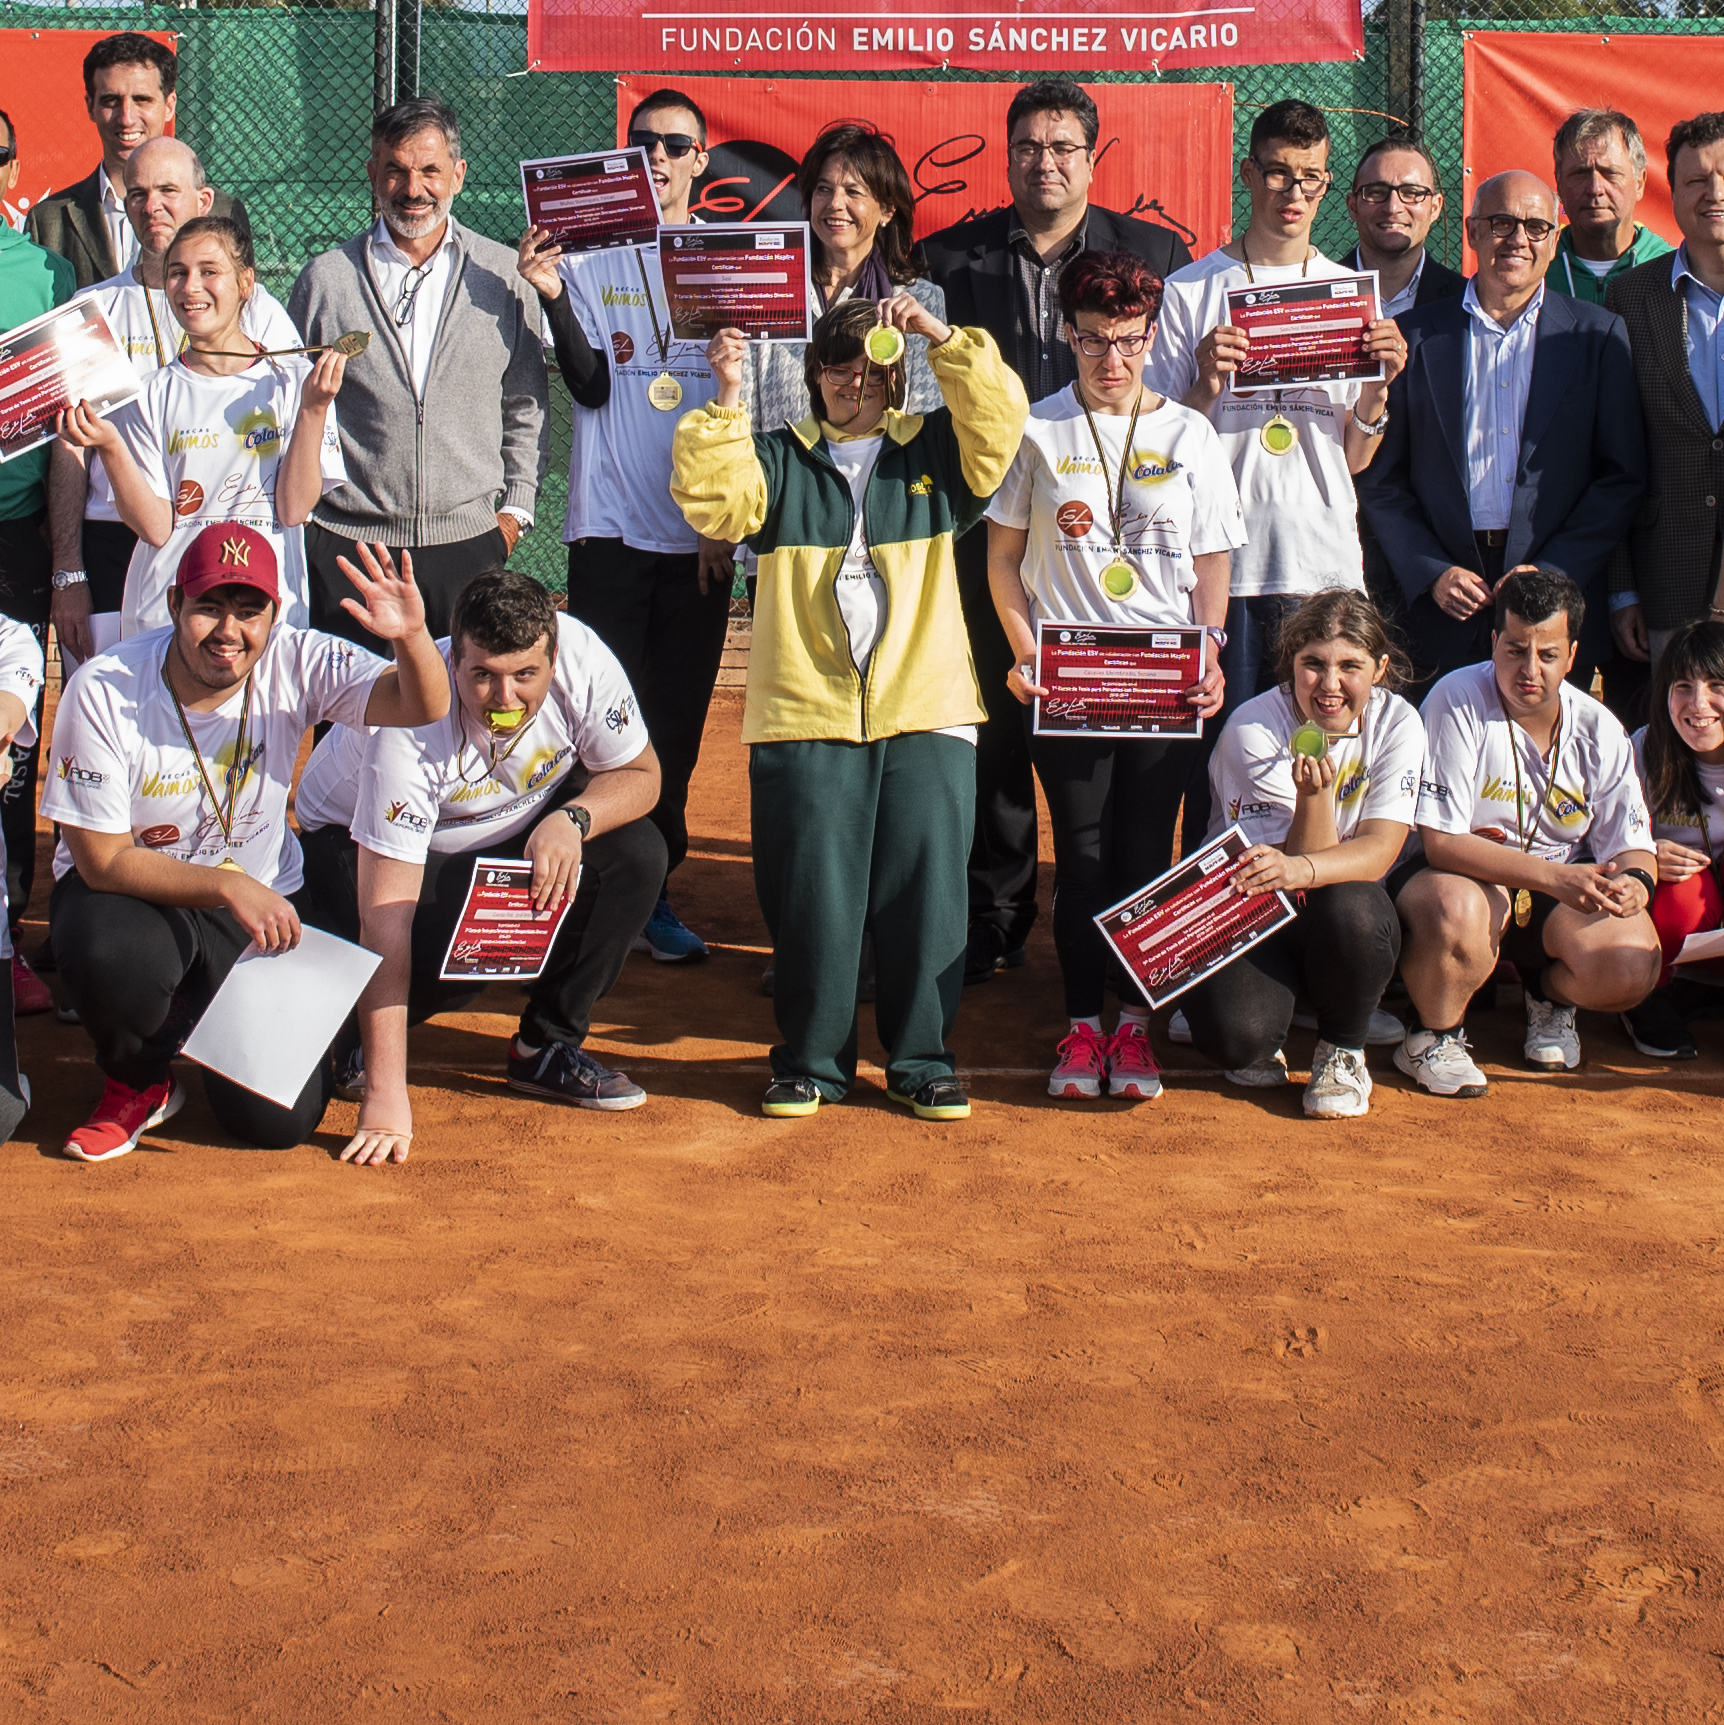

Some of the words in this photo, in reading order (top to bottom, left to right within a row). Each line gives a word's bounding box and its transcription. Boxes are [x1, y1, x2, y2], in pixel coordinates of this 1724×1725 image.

[661, 21, 836, 53] FUNDACIÓN
[853, 27, 954, 53] EMILIO
[969, 22, 1107, 52] SÁNCHEZ
[1121, 24, 1238, 49] VICARIO
[221, 536, 252, 568] NY
